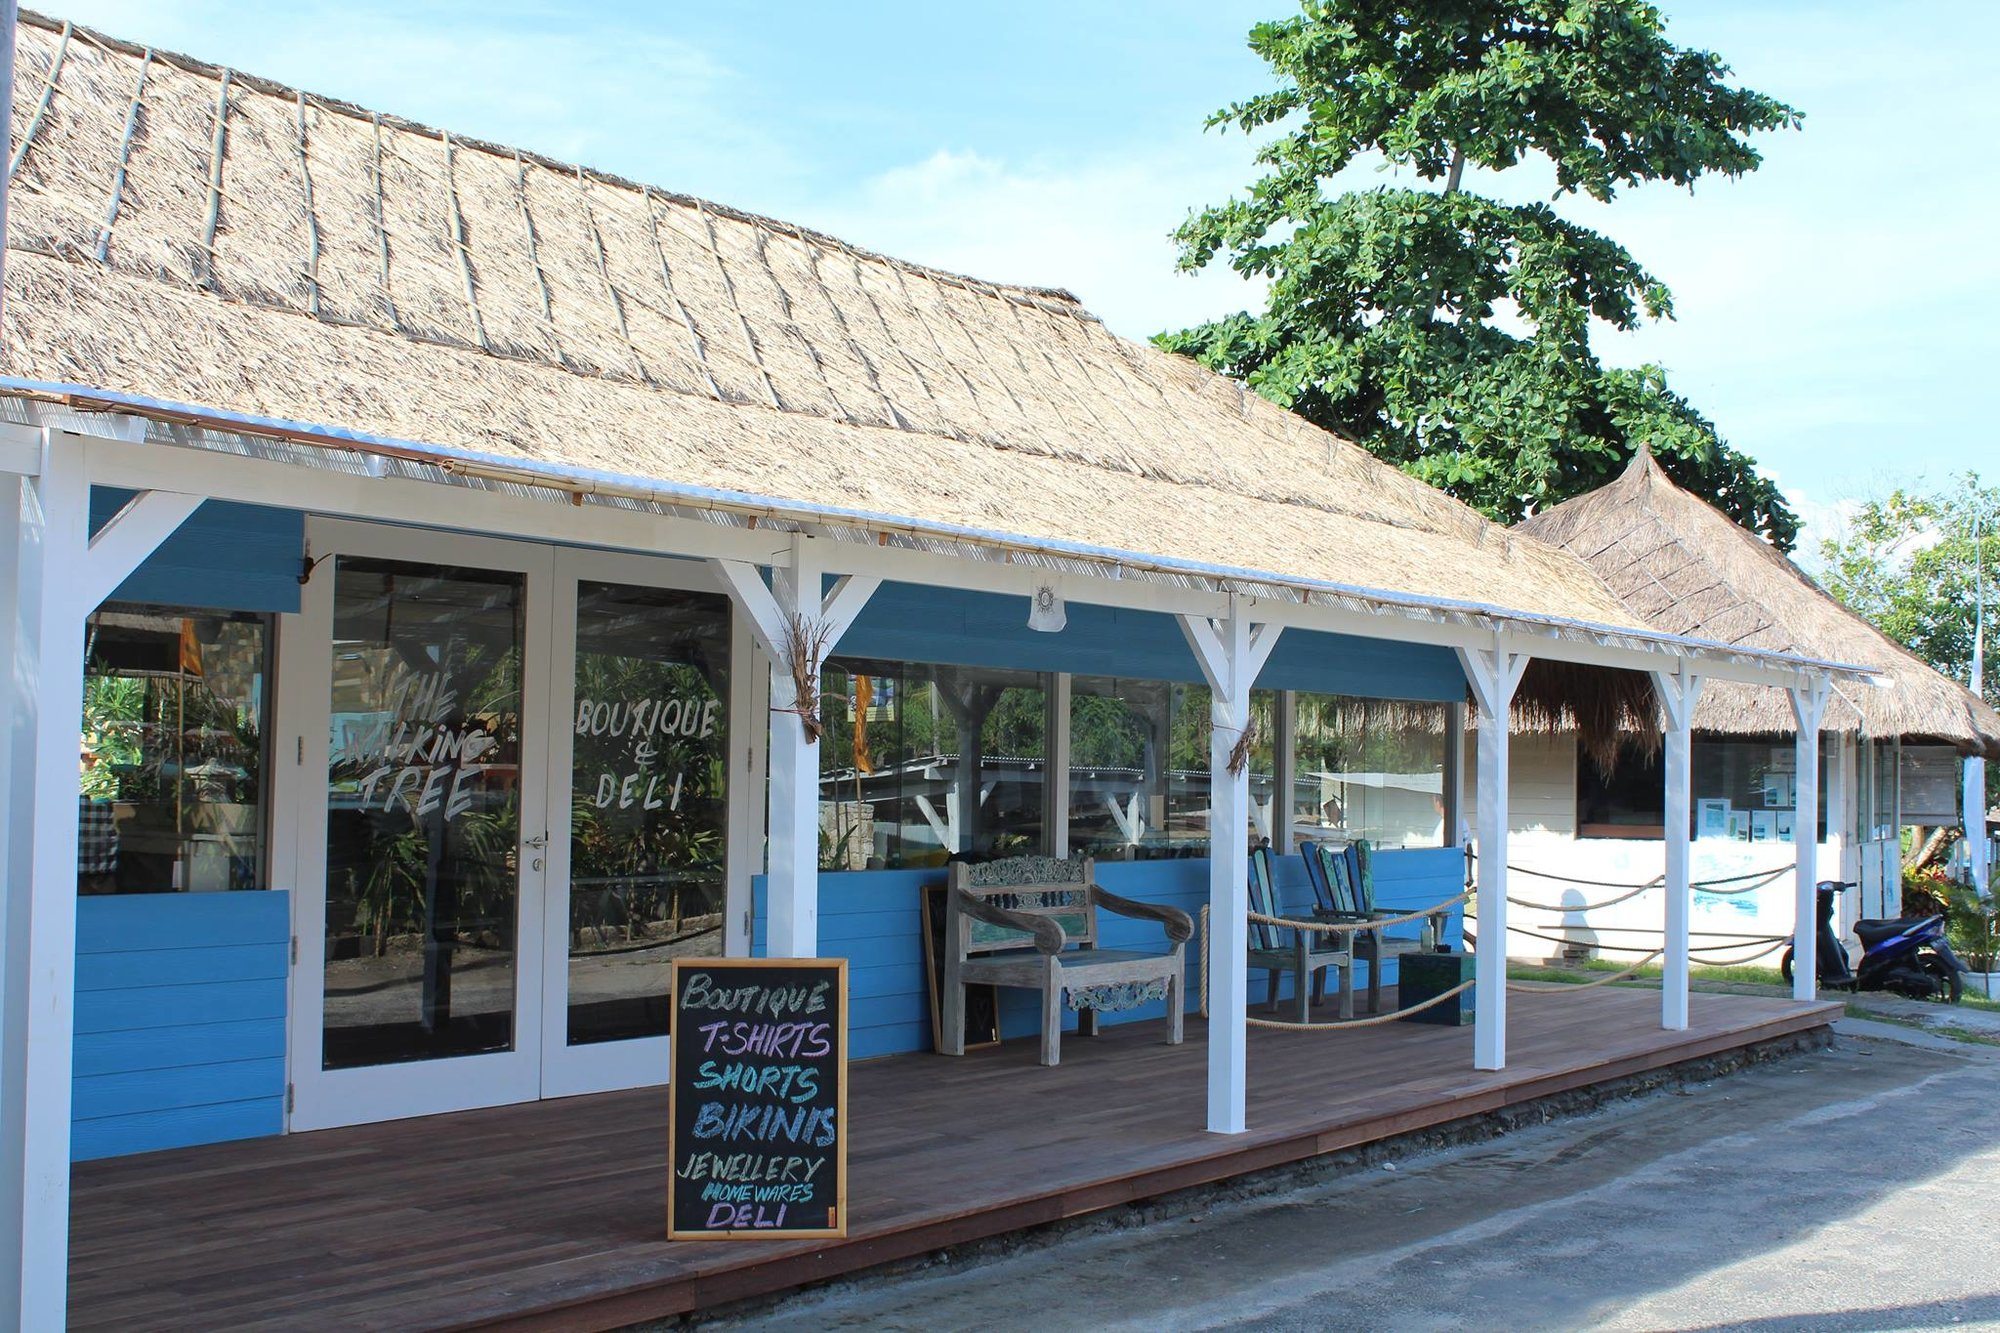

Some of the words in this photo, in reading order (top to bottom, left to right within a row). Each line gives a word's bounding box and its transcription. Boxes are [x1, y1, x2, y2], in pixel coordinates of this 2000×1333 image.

[394, 671, 458, 723] THE
[576, 698, 722, 738] BOUTIQUE
[634, 740, 658, 765] &
[359, 765, 483, 822] TREE
[596, 772, 683, 812] DELI
[680, 973, 830, 1020] BOUTIQUE
[699, 1020, 831, 1058] T-SHIRTS
[693, 1060, 820, 1104] SHORTS
[692, 1101, 835, 1147] BIKINIS
[677, 1151, 826, 1183] JEWELLERY
[706, 1203, 788, 1229] DELI
